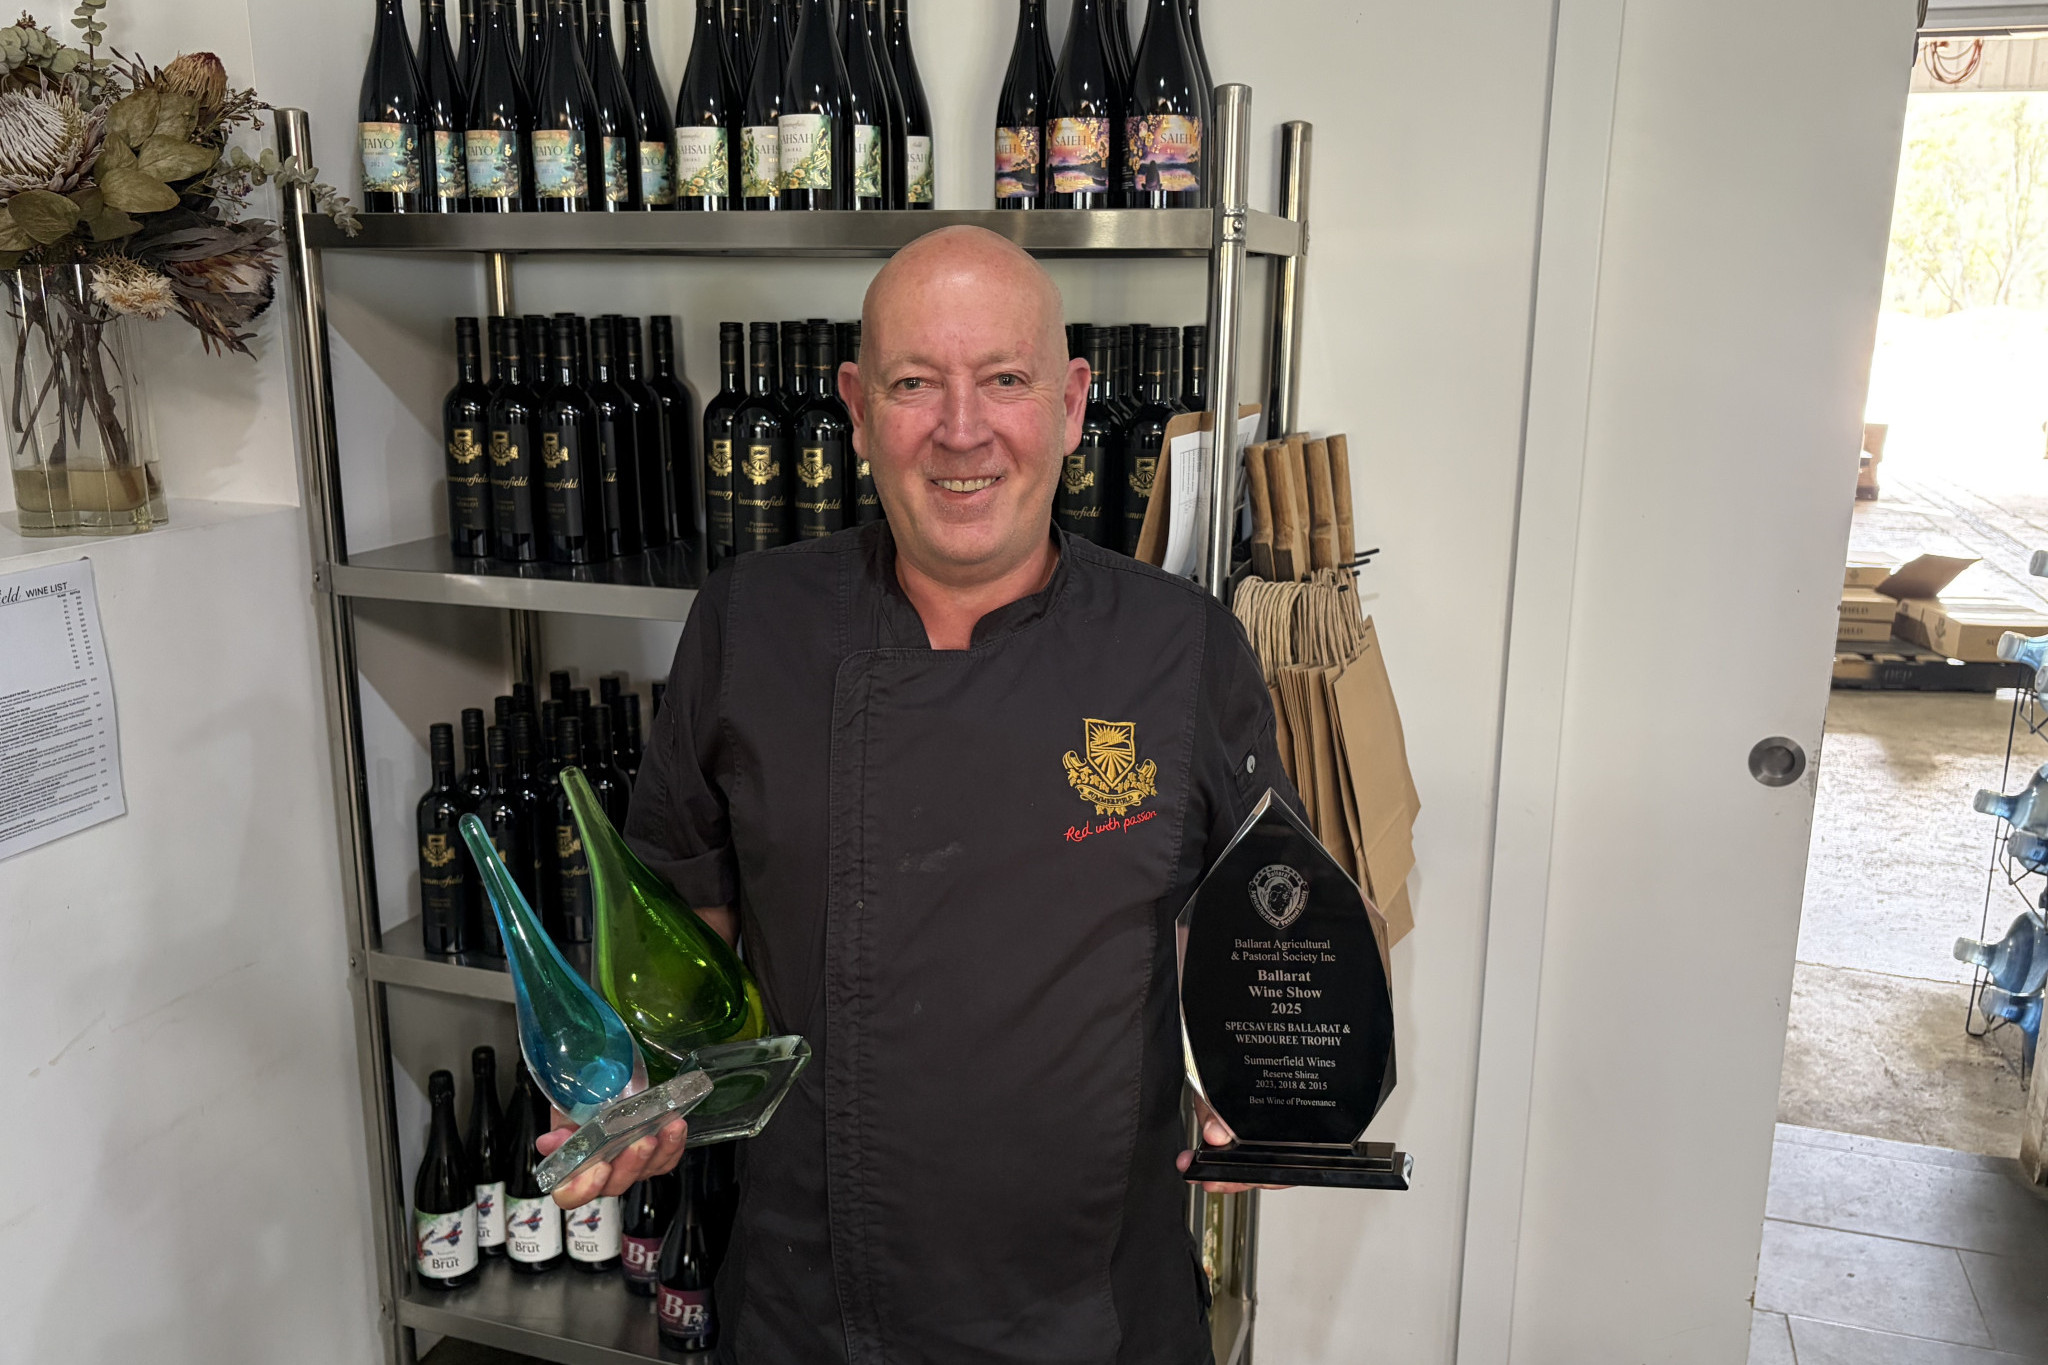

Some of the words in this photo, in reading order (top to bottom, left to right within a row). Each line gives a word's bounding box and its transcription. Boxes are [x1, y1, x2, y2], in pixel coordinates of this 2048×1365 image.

[360, 138, 395, 150] TAIYO
[1055, 135, 1087, 147] SAIEH
[1160, 133, 1192, 145] SAIEH
[25, 586, 49, 598] WINE
[50, 581, 68, 594] LIST
[1063, 820, 1094, 842] Red
[1095, 817, 1121, 834] with
[1123, 810, 1158, 835] passion
[1265, 869, 1291, 879] Ballarat
[1234, 939, 1271, 949] Ballarat
[1273, 939, 1331, 951] Agricultural
[1230, 951, 1240, 961] &
[1242, 951, 1280, 961] Pastoral
[1282, 951, 1318, 964] Society
[1320, 952, 1336, 962] Inc
[1257, 969, 1311, 982] Ballarat
[1248, 985, 1283, 998] Wine
[1286, 986, 1322, 999] Show
[1271, 1002, 1302, 1015] 2025
[1225, 1021, 1286, 1032] SPECSAVERS
[1288, 1023, 1340, 1034] BALLARAT
[1342, 1024, 1351, 1034] &
[1235, 1034, 1299, 1045] WENDOUREE
[1300, 1035, 1342, 1046] TROPHY
[1243, 1054, 1305, 1067] Summerfield
[1307, 1056, 1336, 1068] Wines
[1262, 1069, 1293, 1079] Reserve
[1294, 1070, 1320, 1080] Shiraz
[1255, 1080, 1277, 1090] 2023,
[1278, 1080, 1298, 1089] 2018
[1298, 1081, 1307, 1090] &
[1308, 1081, 1328, 1091] 2015
[1249, 1096, 1265, 1104] Best
[1266, 1096, 1285, 1105] Wine
[1286, 1097, 1295, 1105] of
[1295, 1097, 1337, 1107] Provenance
[515, 1241, 541, 1253] Brut
[574, 1240, 600, 1253] Brut
[432, 1257, 460, 1270] Brut
